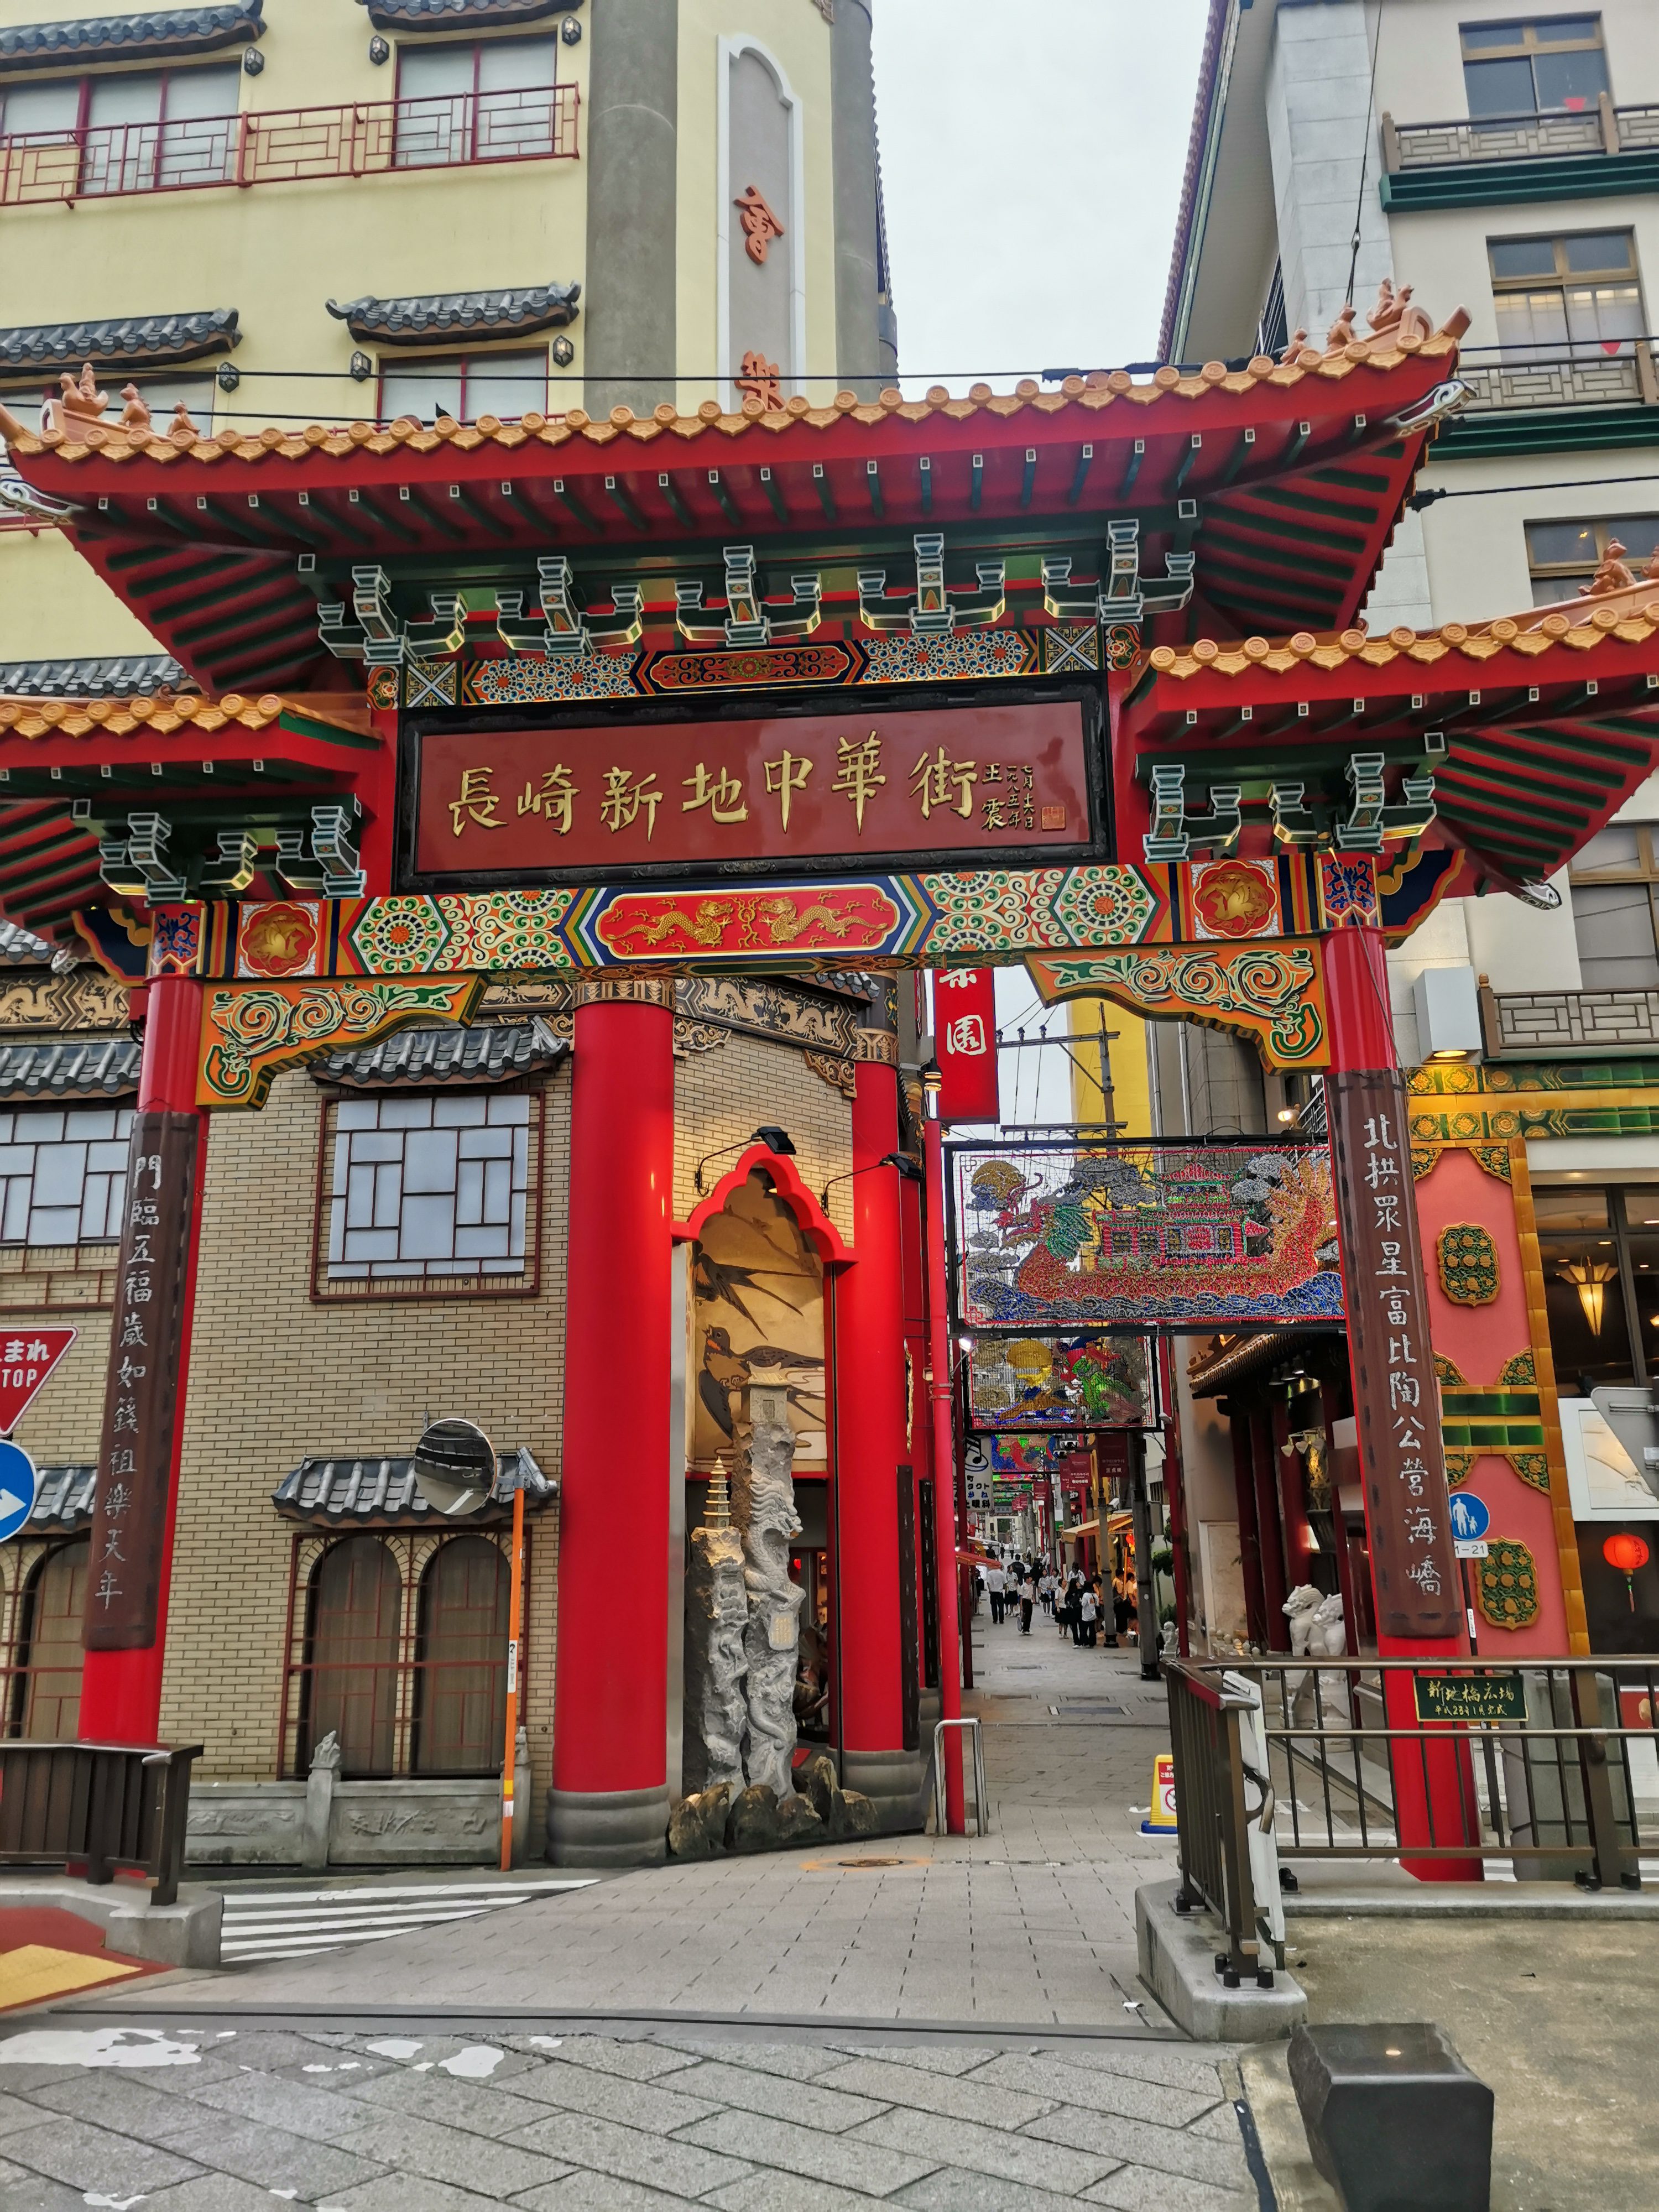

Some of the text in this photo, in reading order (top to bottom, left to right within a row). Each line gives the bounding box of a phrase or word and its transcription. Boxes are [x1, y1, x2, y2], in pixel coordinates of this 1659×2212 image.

[447, 730, 979, 843] 長崎新地中華街
[0, 1339, 50, 1363] まれ
[1, 1368, 37, 1388] TOP
